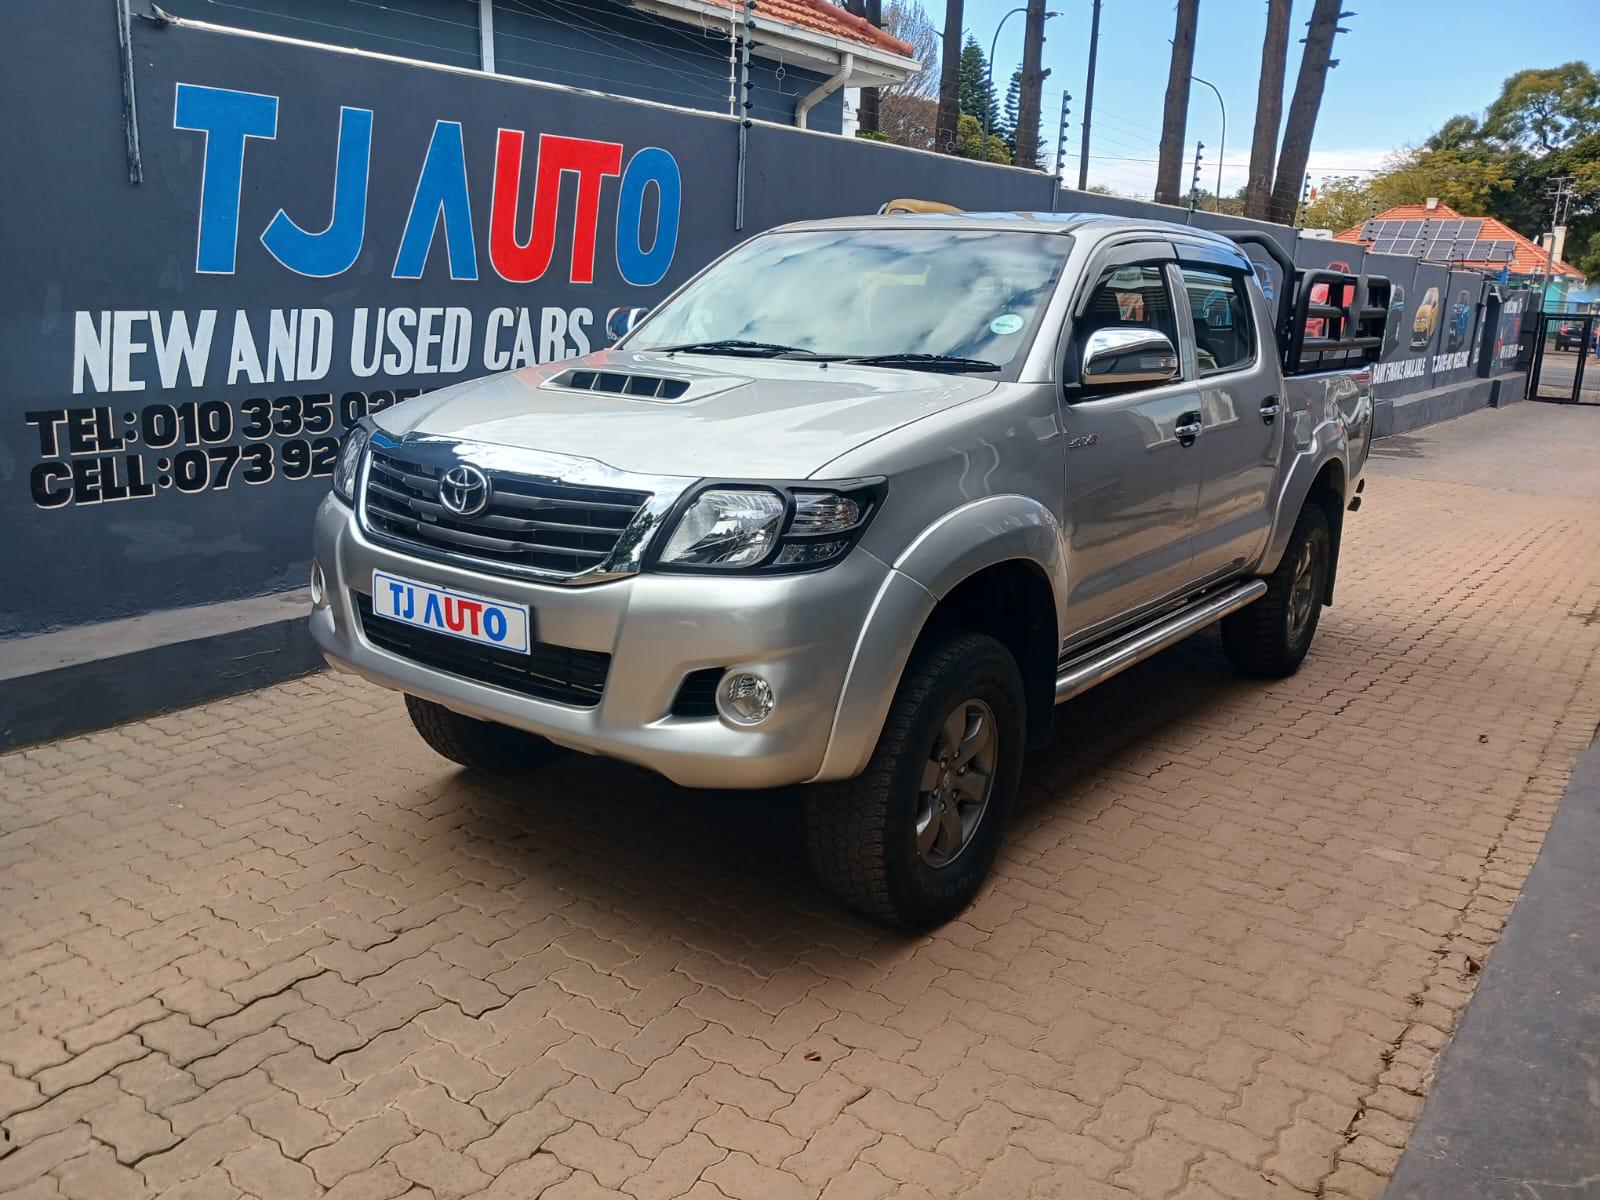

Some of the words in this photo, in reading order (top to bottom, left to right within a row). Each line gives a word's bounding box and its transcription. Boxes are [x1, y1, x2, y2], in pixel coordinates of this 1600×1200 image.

[173, 82, 374, 278] TJ
[391, 119, 682, 286] AUTO
[72, 309, 218, 394] NEW
[226, 308, 334, 385] AND
[350, 307, 473, 378] USED
[483, 307, 594, 371] CARS
[240, 394, 334, 440] 335
[281, 436, 348, 480] 92
[389, 582, 415, 620] TJ
[424, 593, 507, 642] AUTO
